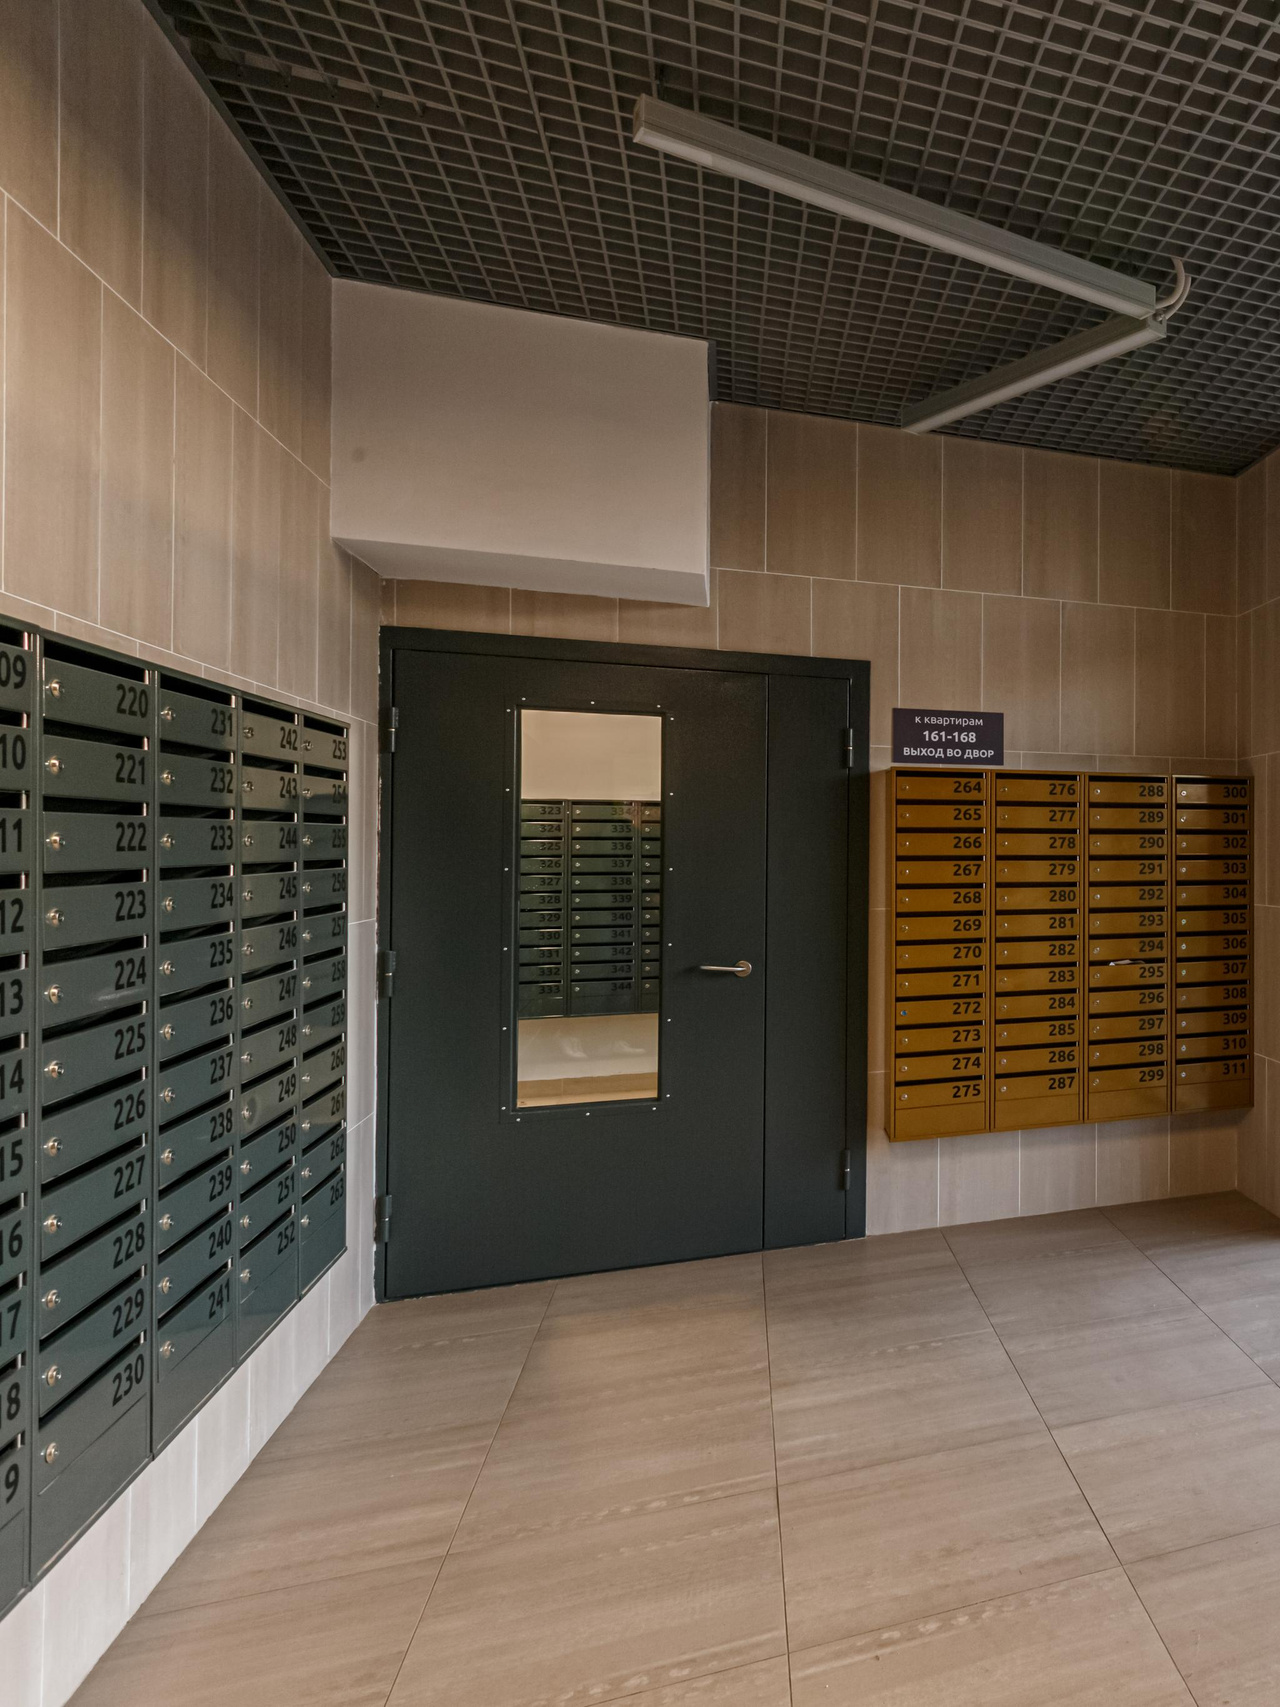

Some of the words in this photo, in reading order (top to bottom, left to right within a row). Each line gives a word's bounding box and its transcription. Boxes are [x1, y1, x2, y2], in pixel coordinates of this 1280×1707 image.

[116, 683, 149, 719] 220
[211, 708, 234, 737] 231
[924, 716, 984, 727] квартирам
[279, 726, 298, 751] 242
[923, 730, 977, 743] 161-168
[332, 735, 347, 761] 253
[903, 747, 945, 759] ВЫХОД
[946, 748, 962, 758] ВО
[964, 749, 995, 760] ДВОР
[115, 752, 146, 785] 221
[210, 767, 233, 794] 232
[952, 780, 982, 794] 264
[279, 776, 298, 800] 243
[1048, 783, 1076, 796] 276
[1138, 785, 1164, 798] 288
[1222, 786, 1247, 799] 300
[540, 806, 561, 815] 323
[952, 808, 982, 822] 265
[1048, 809, 1076, 823] 277
[1138, 810, 1164, 824] 289
[1222, 811, 1247, 824] 301
[540, 824, 561, 833] 324
[611, 824, 631, 833] 335
[115, 822, 147, 852] 222
[210, 825, 233, 851] 233
[279, 827, 297, 849] 244
[332, 829, 346, 849] 255
[952, 836, 982, 849] 266
[1048, 836, 1076, 849] 278
[1138, 836, 1164, 850] 290
[1222, 836, 1247, 849] 302
[540, 842, 561, 851] 325
[611, 842, 631, 851] 336
[540, 860, 561, 869] 326
[611, 859, 631, 868] 337
[952, 863, 982, 877] 267
[1048, 863, 1076, 876] 279
[1138, 862, 1164, 875] 291
[1222, 861, 1247, 874] 303
[279, 876, 297, 900] 245
[331, 873, 346, 892] 256
[540, 877, 561, 887] 327
[611, 877, 631, 886] 338
[210, 882, 233, 910] 234
[540, 895, 560, 904] 328
[611, 894, 631, 903] 339
[952, 891, 982, 905] 268
[1048, 889, 1076, 903] 280
[1138, 888, 1164, 901] 292
[1222, 886, 1247, 899] 304
[115, 889, 146, 922] 223
[539, 913, 560, 922] 329
[611, 912, 631, 921] 340
[1048, 916, 1076, 930] 281
[1138, 914, 1164, 927] 293
[1222, 911, 1247, 924] 305
[331, 915, 346, 937] 257
[952, 918, 982, 932] 269
[279, 926, 297, 949] 246
[539, 931, 560, 940] 330
[611, 929, 631, 938] 341
[1048, 943, 1076, 956] 282
[1138, 939, 1164, 953] 294
[1222, 936, 1247, 949] 306
[210, 939, 233, 968] 235
[539, 949, 560, 958] 331
[611, 947, 631, 956] 342
[952, 946, 982, 960] 270
[115, 956, 146, 991] 224
[331, 960, 346, 982] 258
[539, 967, 560, 976] 332
[611, 965, 631, 973] 343
[1138, 965, 1164, 979] 295
[1222, 961, 1247, 974] 307
[952, 974, 982, 987] 271
[1048, 970, 1076, 983] 283
[278, 976, 297, 1000] 247
[539, 985, 560, 994] 333
[611, 982, 631, 991] 344
[1222, 986, 1247, 999] 308
[1048, 996, 1076, 1010] 284
[1138, 991, 1164, 1004] 296
[210, 996, 233, 1026] 236
[952, 1001, 982, 1015] 272
[331, 1004, 346, 1027] 259
[1222, 1011, 1247, 1024] 309
[1048, 1023, 1076, 1036] 285
[1138, 1017, 1164, 1030] 297
[114, 1022, 146, 1060] 225
[278, 1025, 297, 1050] 248
[952, 1029, 982, 1043] 273
[1222, 1036, 1247, 1049] 310
[1048, 1050, 1076, 1063] 286
[1138, 1043, 1164, 1056] 298
[331, 1046, 345, 1071] 260
[952, 1056, 982, 1070] 274
[210, 1052, 233, 1085] 237
[1138, 1068, 1164, 1082] 299
[1222, 1062, 1247, 1074] 311
[278, 1074, 297, 1103] 249
[1048, 1076, 1076, 1090] 287
[952, 1084, 982, 1098] 275
[331, 1089, 346, 1114] 261
[113, 1088, 146, 1131] 226
[210, 1107, 233, 1143] 238
[278, 1123, 297, 1152] 250
[330, 1133, 345, 1158] 262
[113, 1156, 146, 1198] 227
[210, 1164, 233, 1201] 239
[277, 1174, 296, 1205] 251
[330, 1178, 345, 1205] 263
[113, 1222, 145, 1269] 228
[209, 1221, 232, 1260] 240
[277, 1224, 296, 1255] 252
[209, 1278, 232, 1317] 241
[112, 1289, 145, 1338] 229
[112, 1354, 145, 1407] 230
